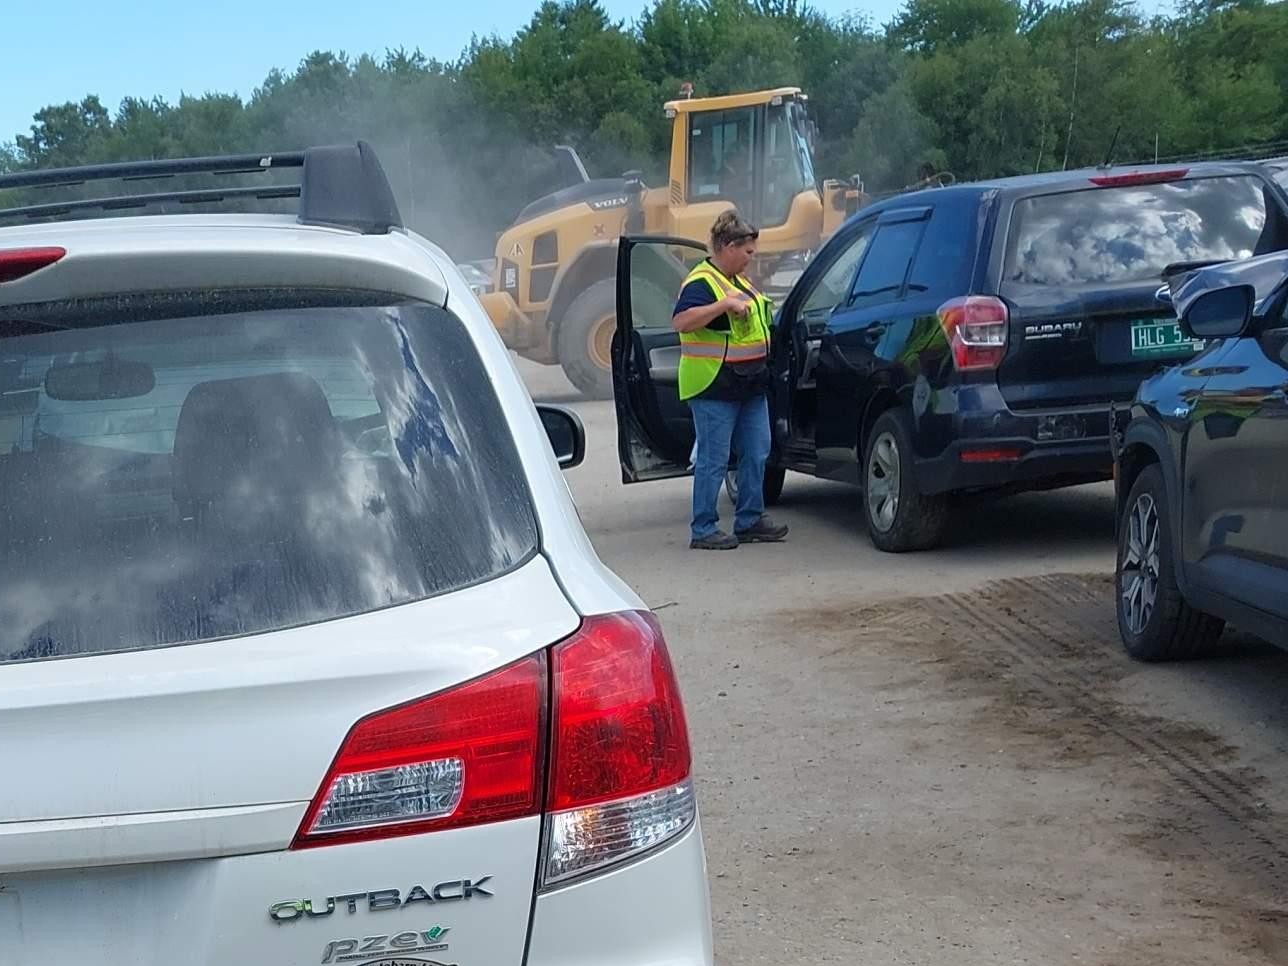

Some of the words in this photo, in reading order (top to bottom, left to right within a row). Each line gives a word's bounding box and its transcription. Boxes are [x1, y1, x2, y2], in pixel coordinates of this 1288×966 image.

[594, 196, 628, 208] VOLV
[1025, 321, 1082, 334] SUBARU
[1138, 327, 1165, 346] HLG
[268, 874, 495, 921] OUTBACK
